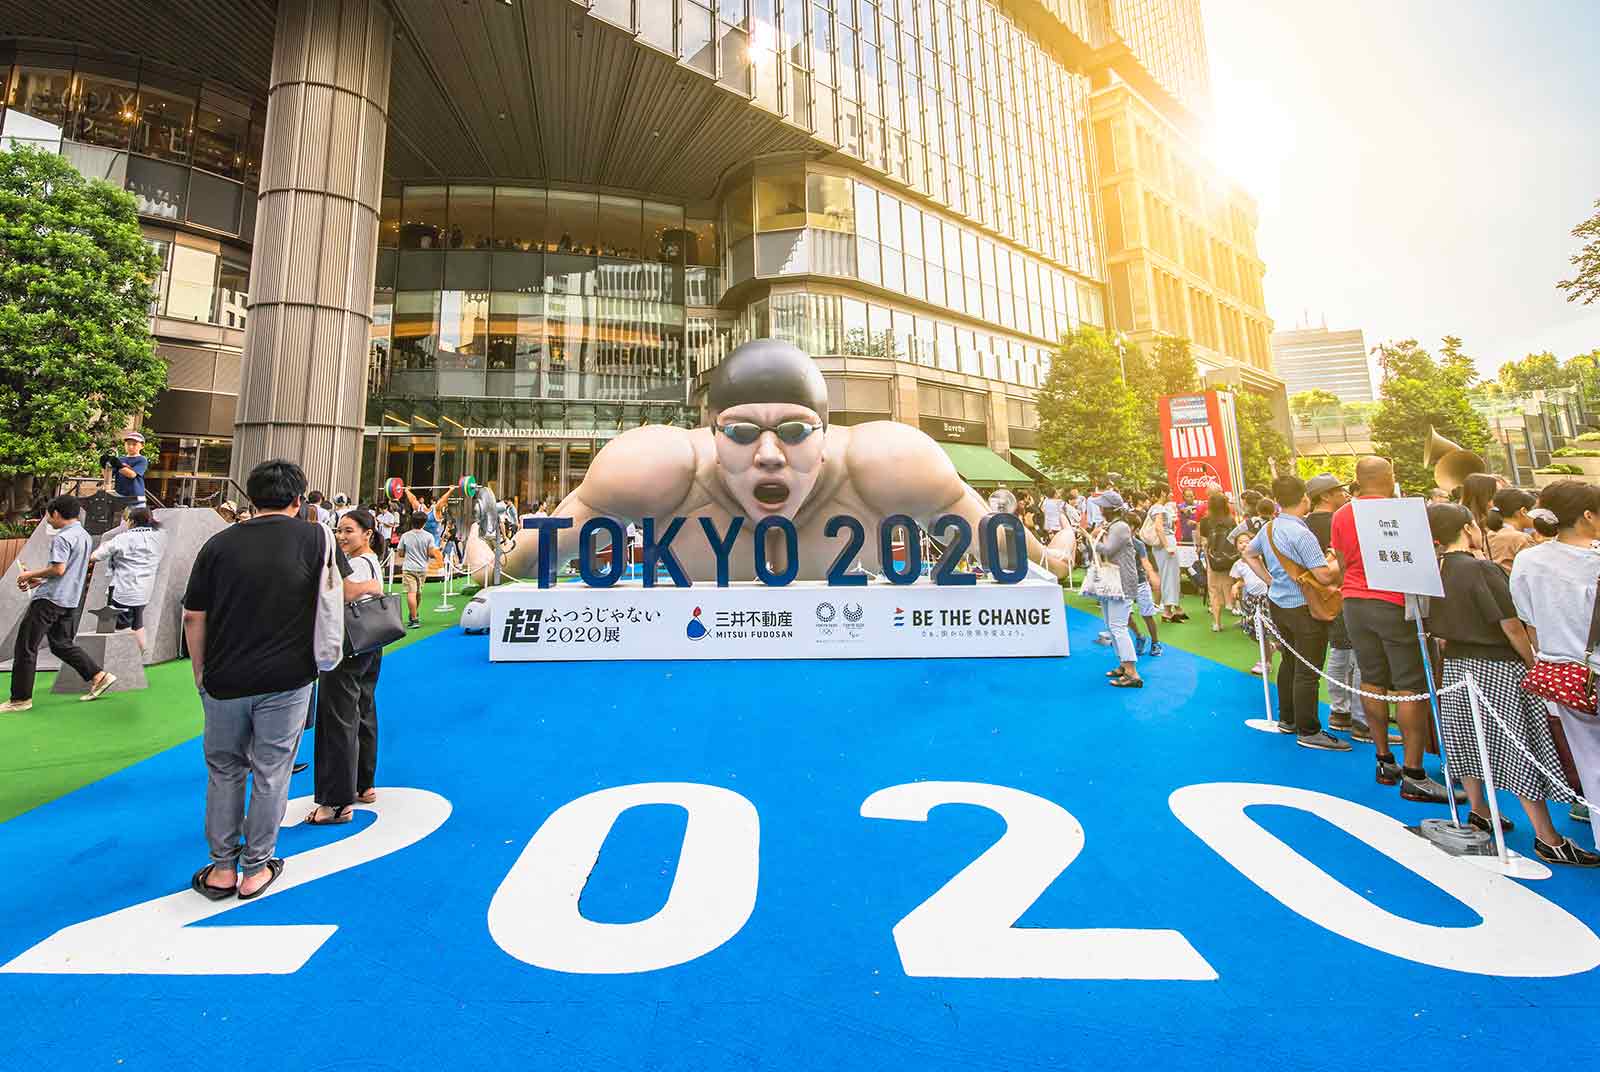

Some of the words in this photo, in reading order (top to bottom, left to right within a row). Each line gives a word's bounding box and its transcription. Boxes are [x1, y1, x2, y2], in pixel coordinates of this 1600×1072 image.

[463, 427, 500, 437] TOKYO
[503, 428, 560, 438] MIDTOWN
[523, 514, 799, 589] TOKYO
[823, 513, 1030, 588] 2020
[1378, 550, 1414, 563] 最後尾
[545, 607, 661, 623] ふつうじゃない
[715, 611, 793, 627] 三井不動産
[912, 610, 933, 626] BE
[940, 610, 972, 626] THE
[978, 609, 1051, 626] CHANGE
[502, 607, 543, 643] 超
[546, 626, 620, 643] 2020展
[0, 782, 1600, 981] 2020
